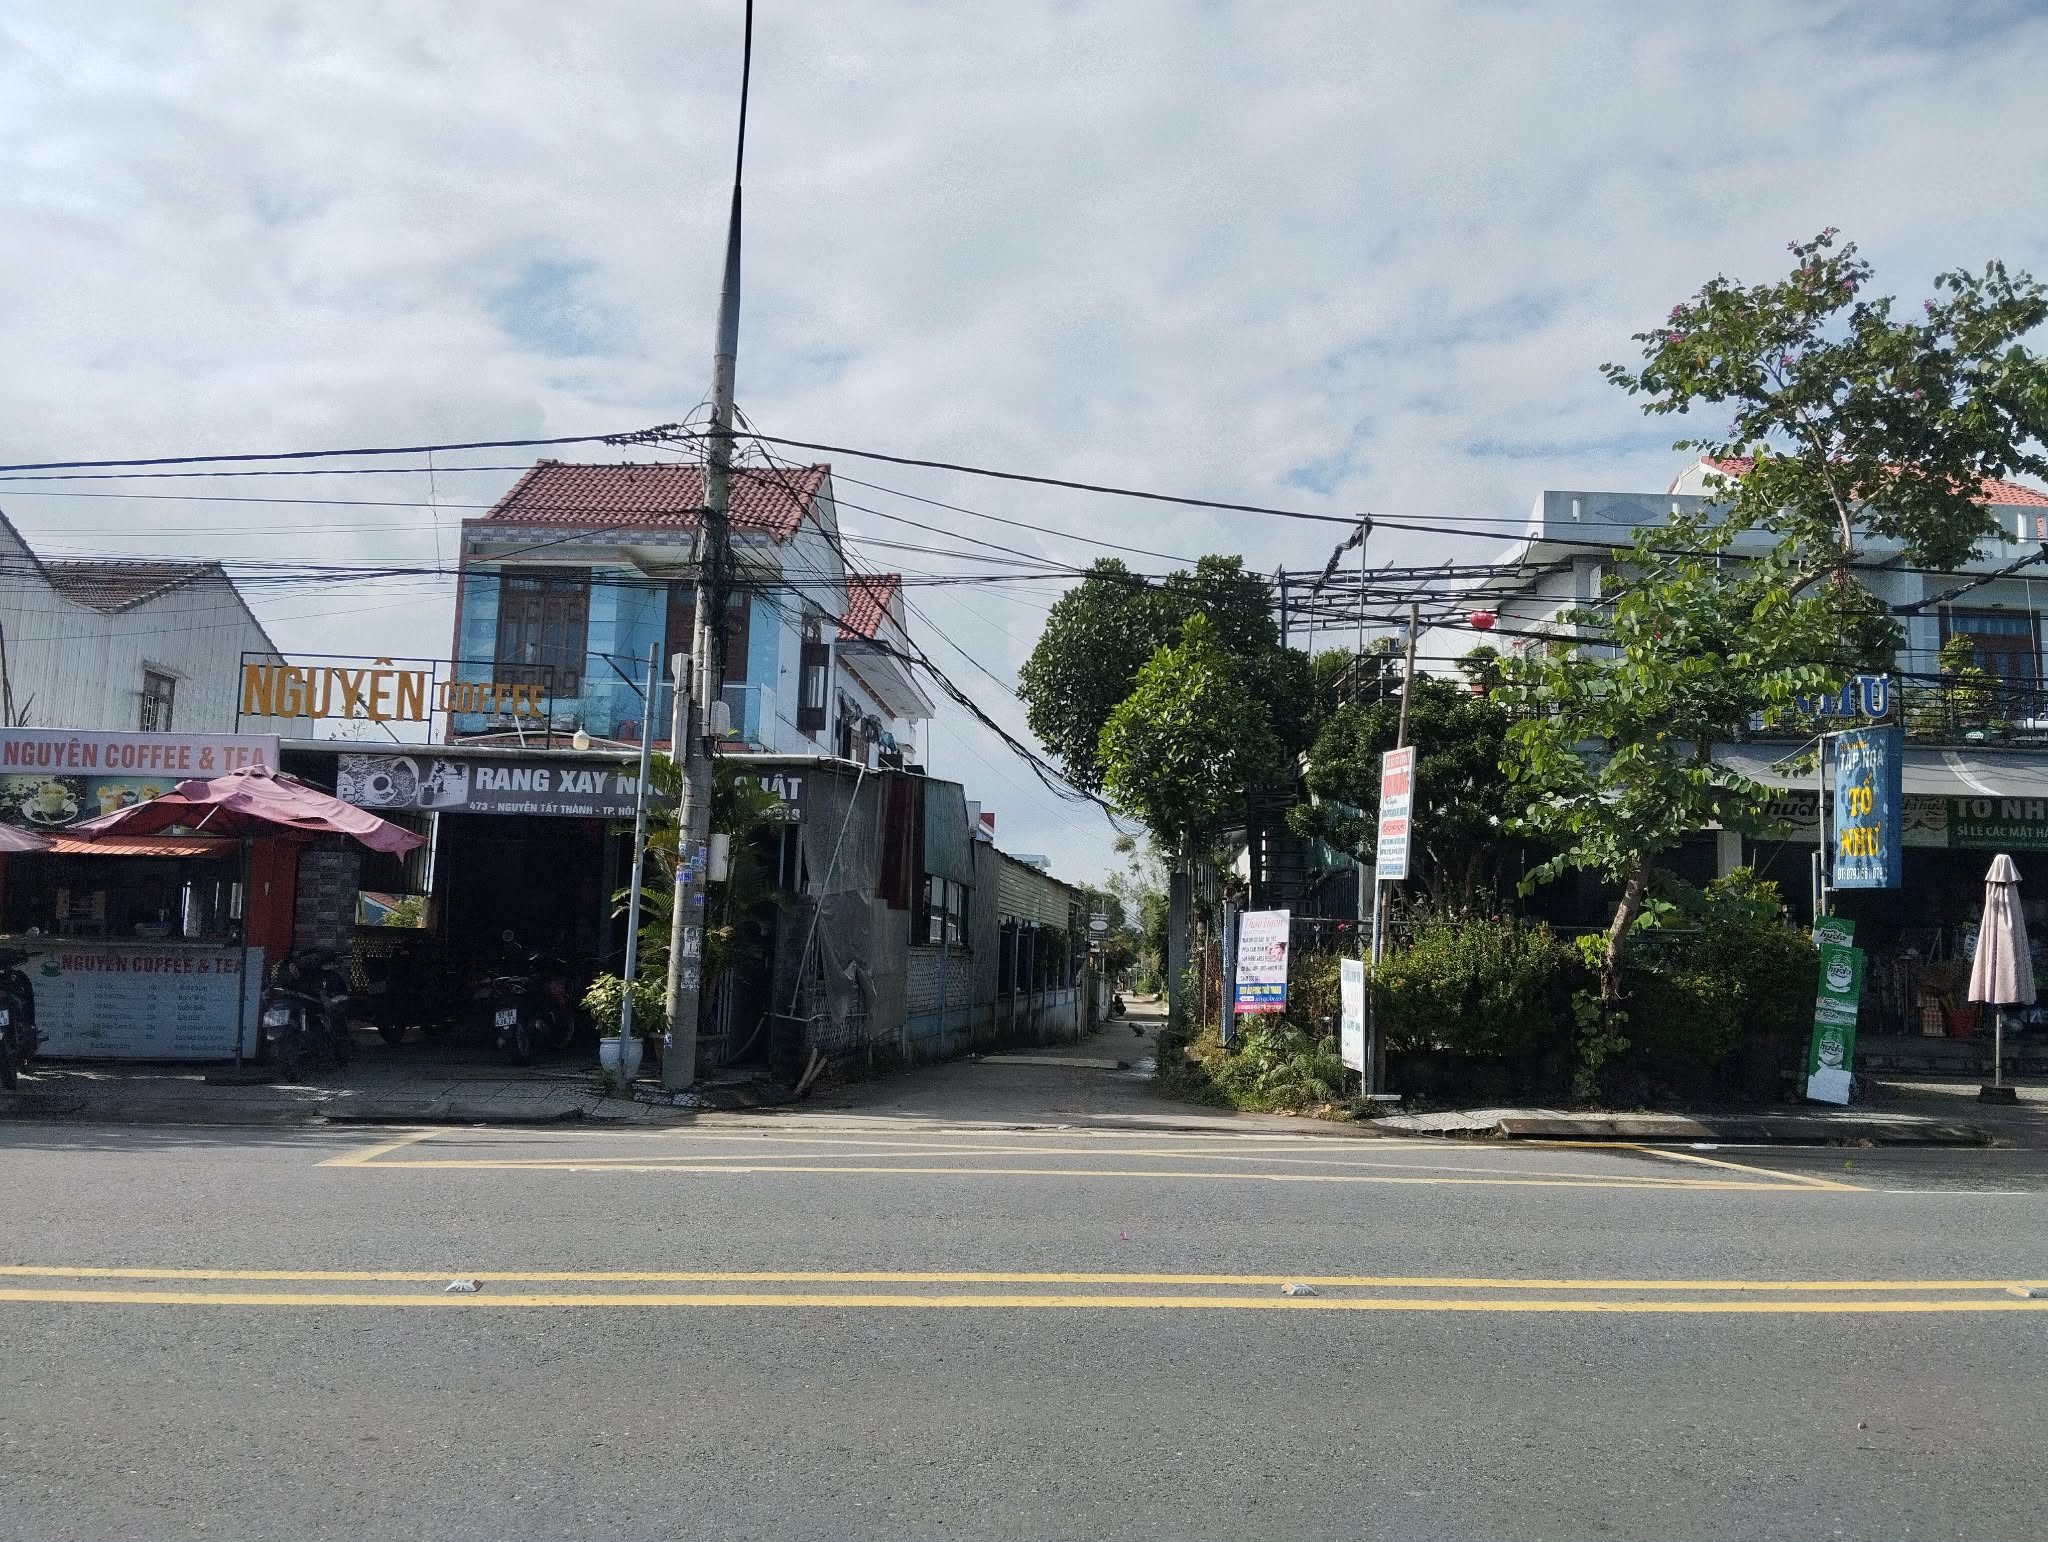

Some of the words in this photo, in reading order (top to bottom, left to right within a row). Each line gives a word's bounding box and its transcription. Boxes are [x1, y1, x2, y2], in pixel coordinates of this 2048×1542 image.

[242, 657, 425, 722] NGUYÊN
[438, 680, 545, 718] COFFEE
[3, 738, 98, 768] NGUYÊN
[105, 743, 190, 769] COFFEE
[199, 745, 214, 770] &
[224, 746, 265, 770] TEA
[475, 767, 550, 792] RANG
[557, 770, 608, 794] XAY
[1848, 772, 1873, 817] TỐ
[469, 801, 488, 811] 473
[497, 800, 538, 812] NGUYỄN
[539, 801, 558, 813] TẤT
[560, 803, 593, 815] THÀNH
[602, 806, 616, 816] TP.
[618, 805, 635, 818] HỘI
